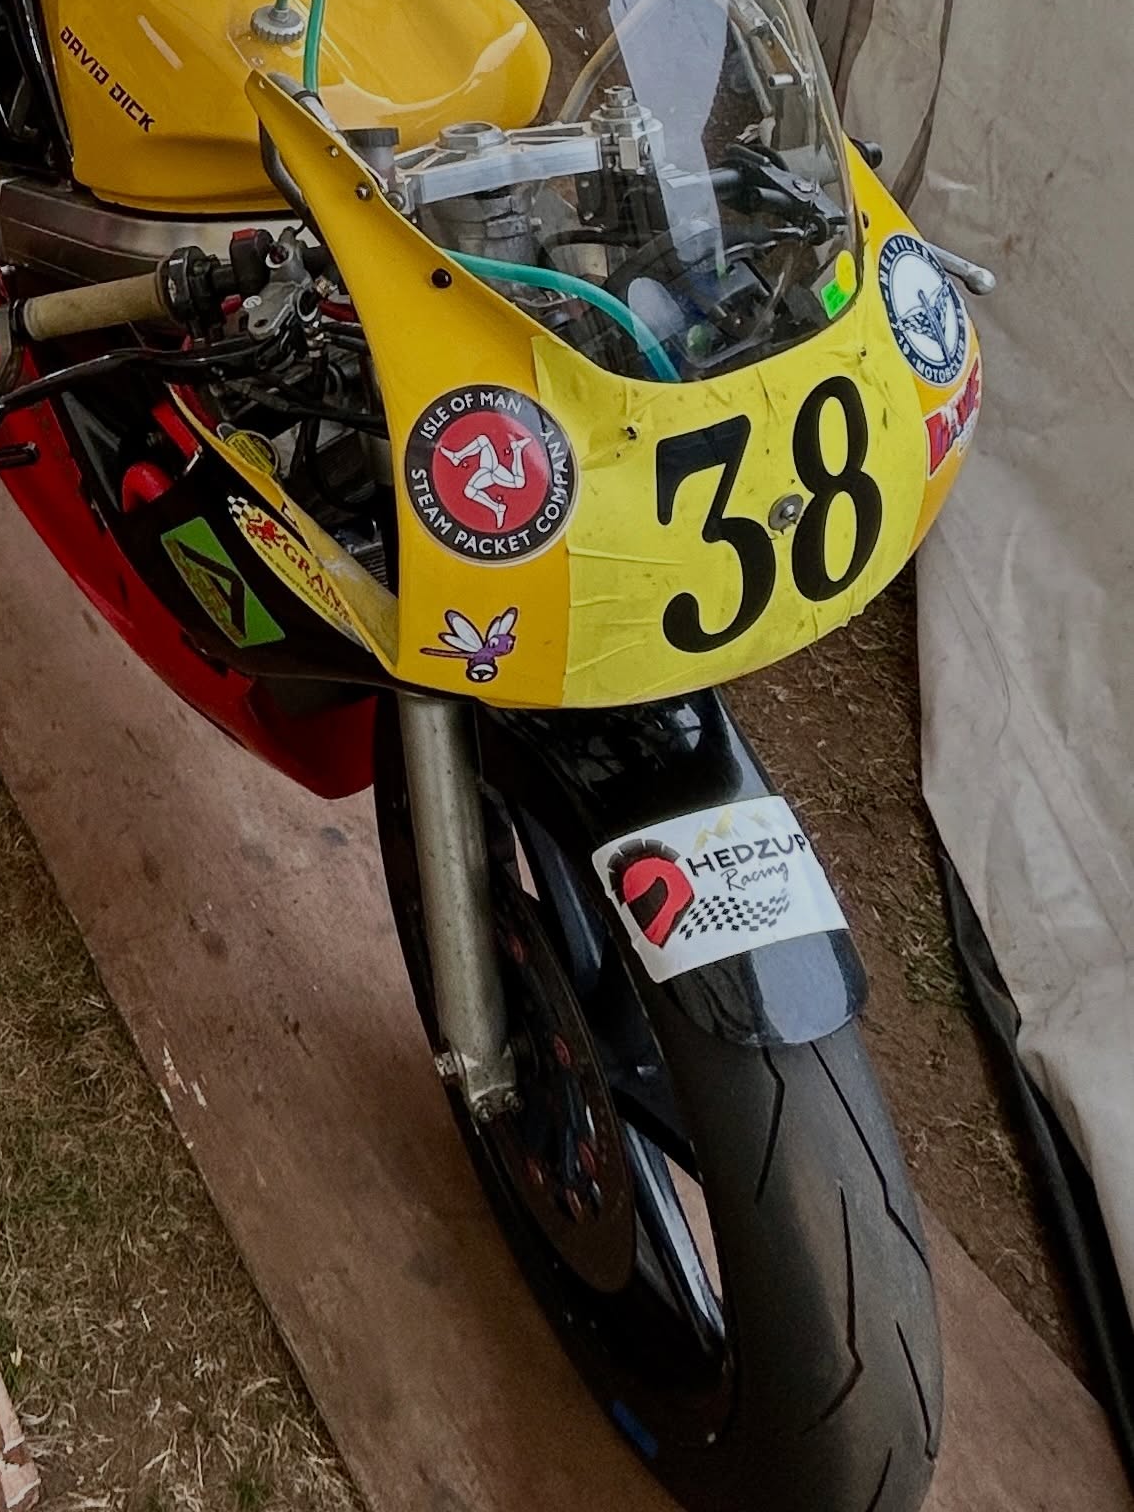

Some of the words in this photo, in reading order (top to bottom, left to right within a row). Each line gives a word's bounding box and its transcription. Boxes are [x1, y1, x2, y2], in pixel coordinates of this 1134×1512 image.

[60, 26, 110, 85] DAVID
[108, 82, 155, 133] DICK
[420, 406, 451, 440] ISLE
[450, 393, 474, 413] OF
[480, 392, 522, 415] MAN
[411, 468, 454, 536] STEAM
[454, 529, 532, 555] PACKET
[536, 427, 569, 534] COMPANY
[656, 375, 883, 653] 38
[685, 833, 806, 877] HEDZUP
[720, 860, 789, 891] Racing
